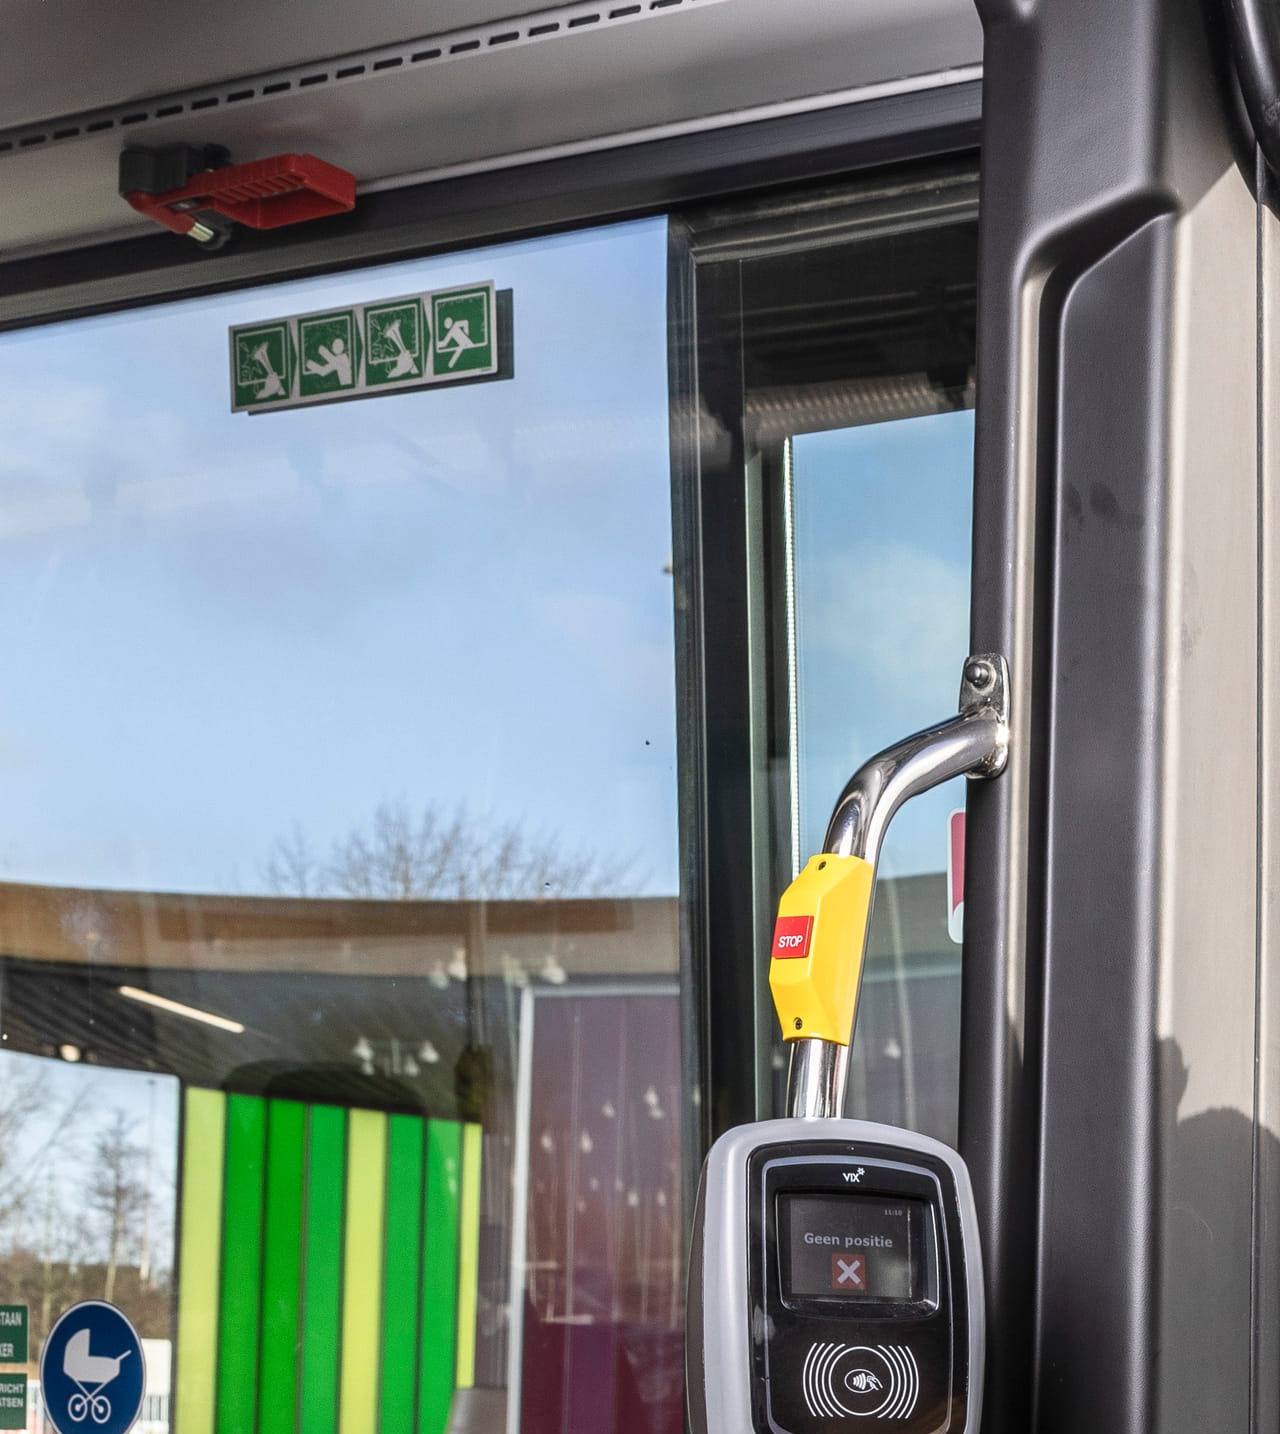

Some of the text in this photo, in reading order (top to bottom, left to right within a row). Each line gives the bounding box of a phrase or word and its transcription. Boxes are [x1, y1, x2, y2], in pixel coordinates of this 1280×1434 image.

[778, 935, 803, 948] STOP
[804, 1232, 893, 1248] Geen positie
[0, 1312, 22, 1326] TAAN
